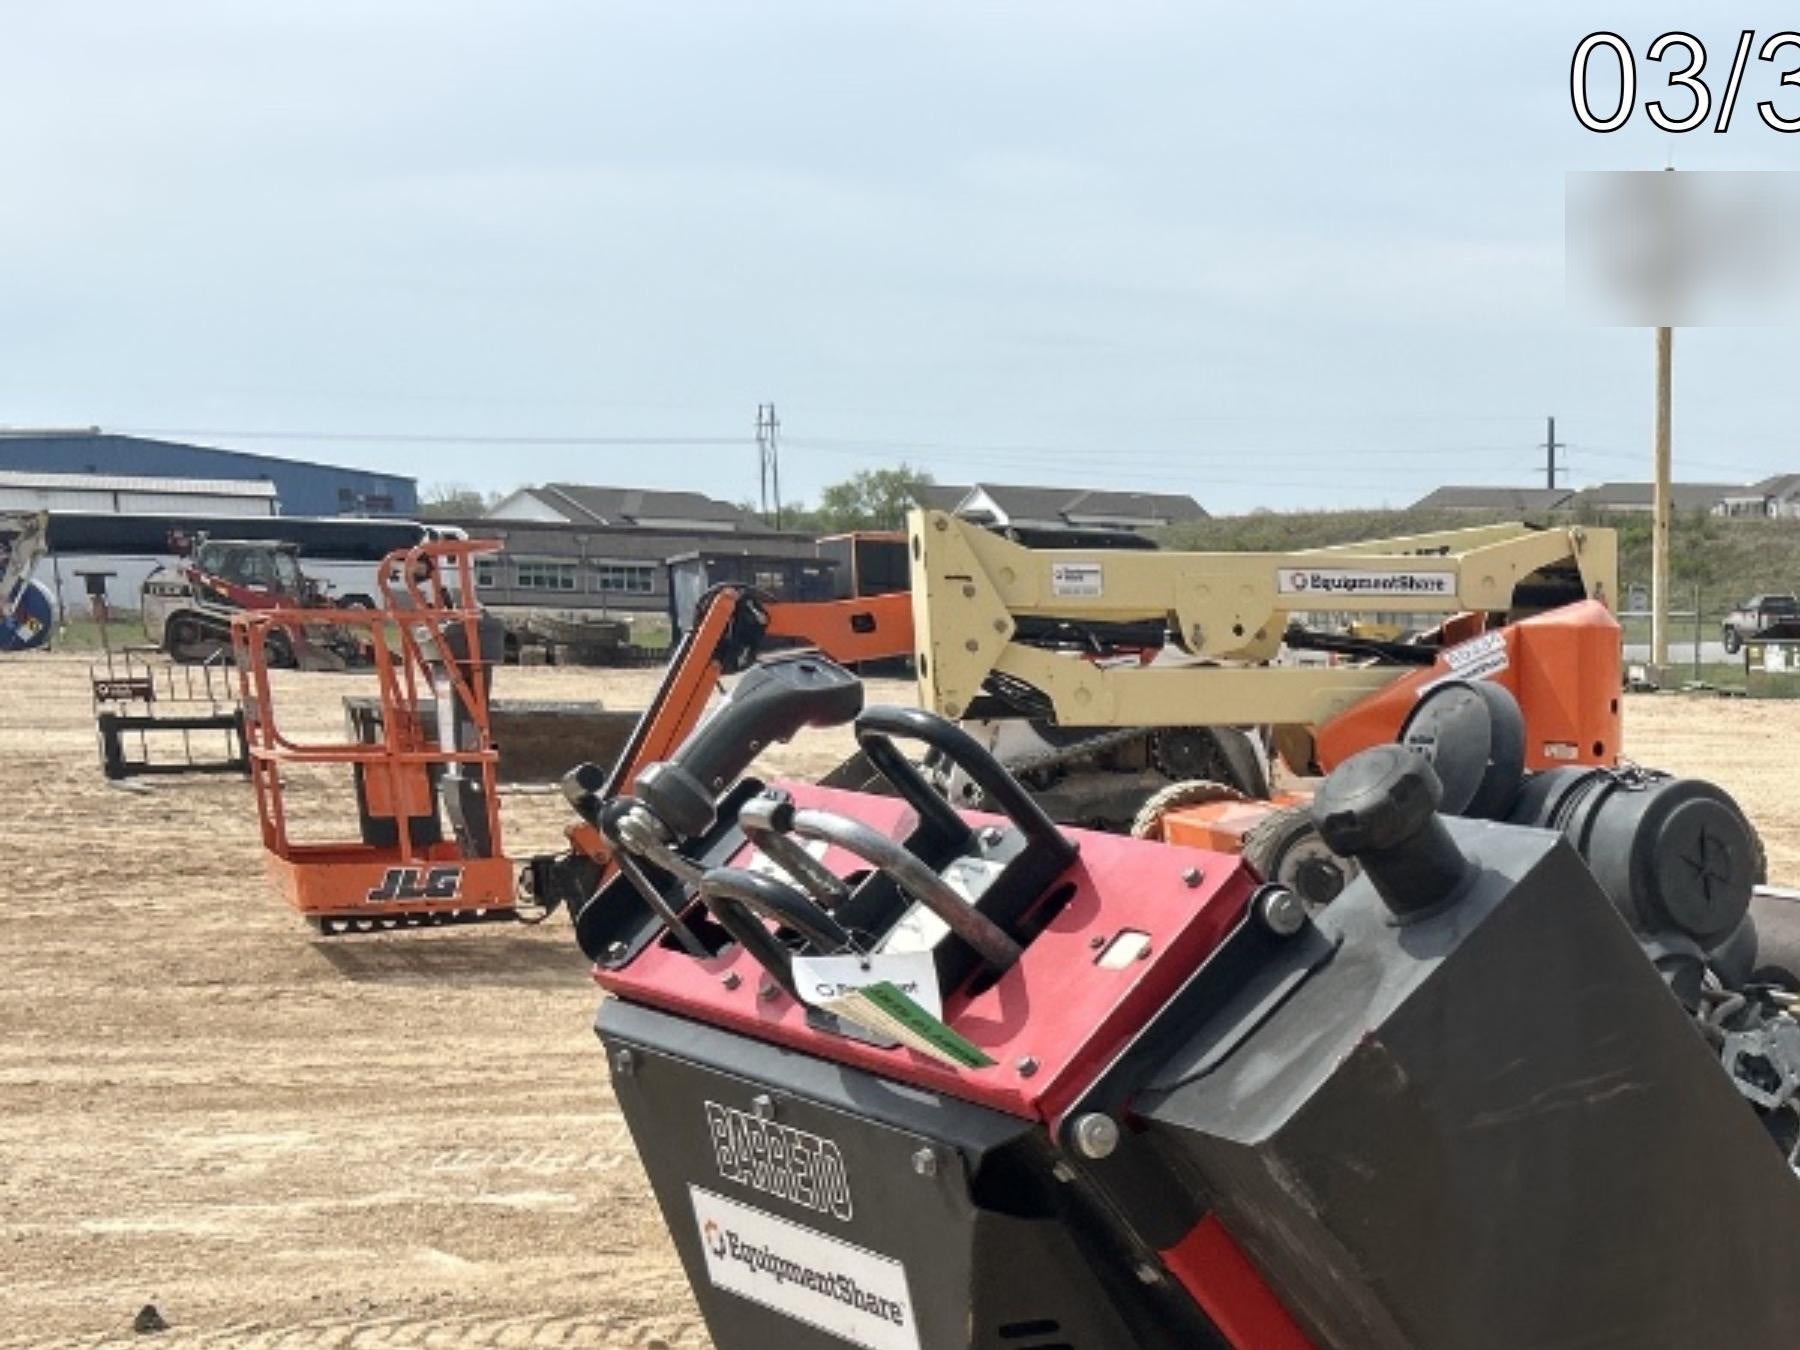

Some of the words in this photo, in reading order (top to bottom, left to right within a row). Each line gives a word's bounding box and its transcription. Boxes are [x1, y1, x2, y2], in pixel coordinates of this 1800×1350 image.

[366, 867, 463, 902] JLG
[704, 1100, 853, 1222] BARRETO
[726, 1229, 904, 1327] EquipmentShare
